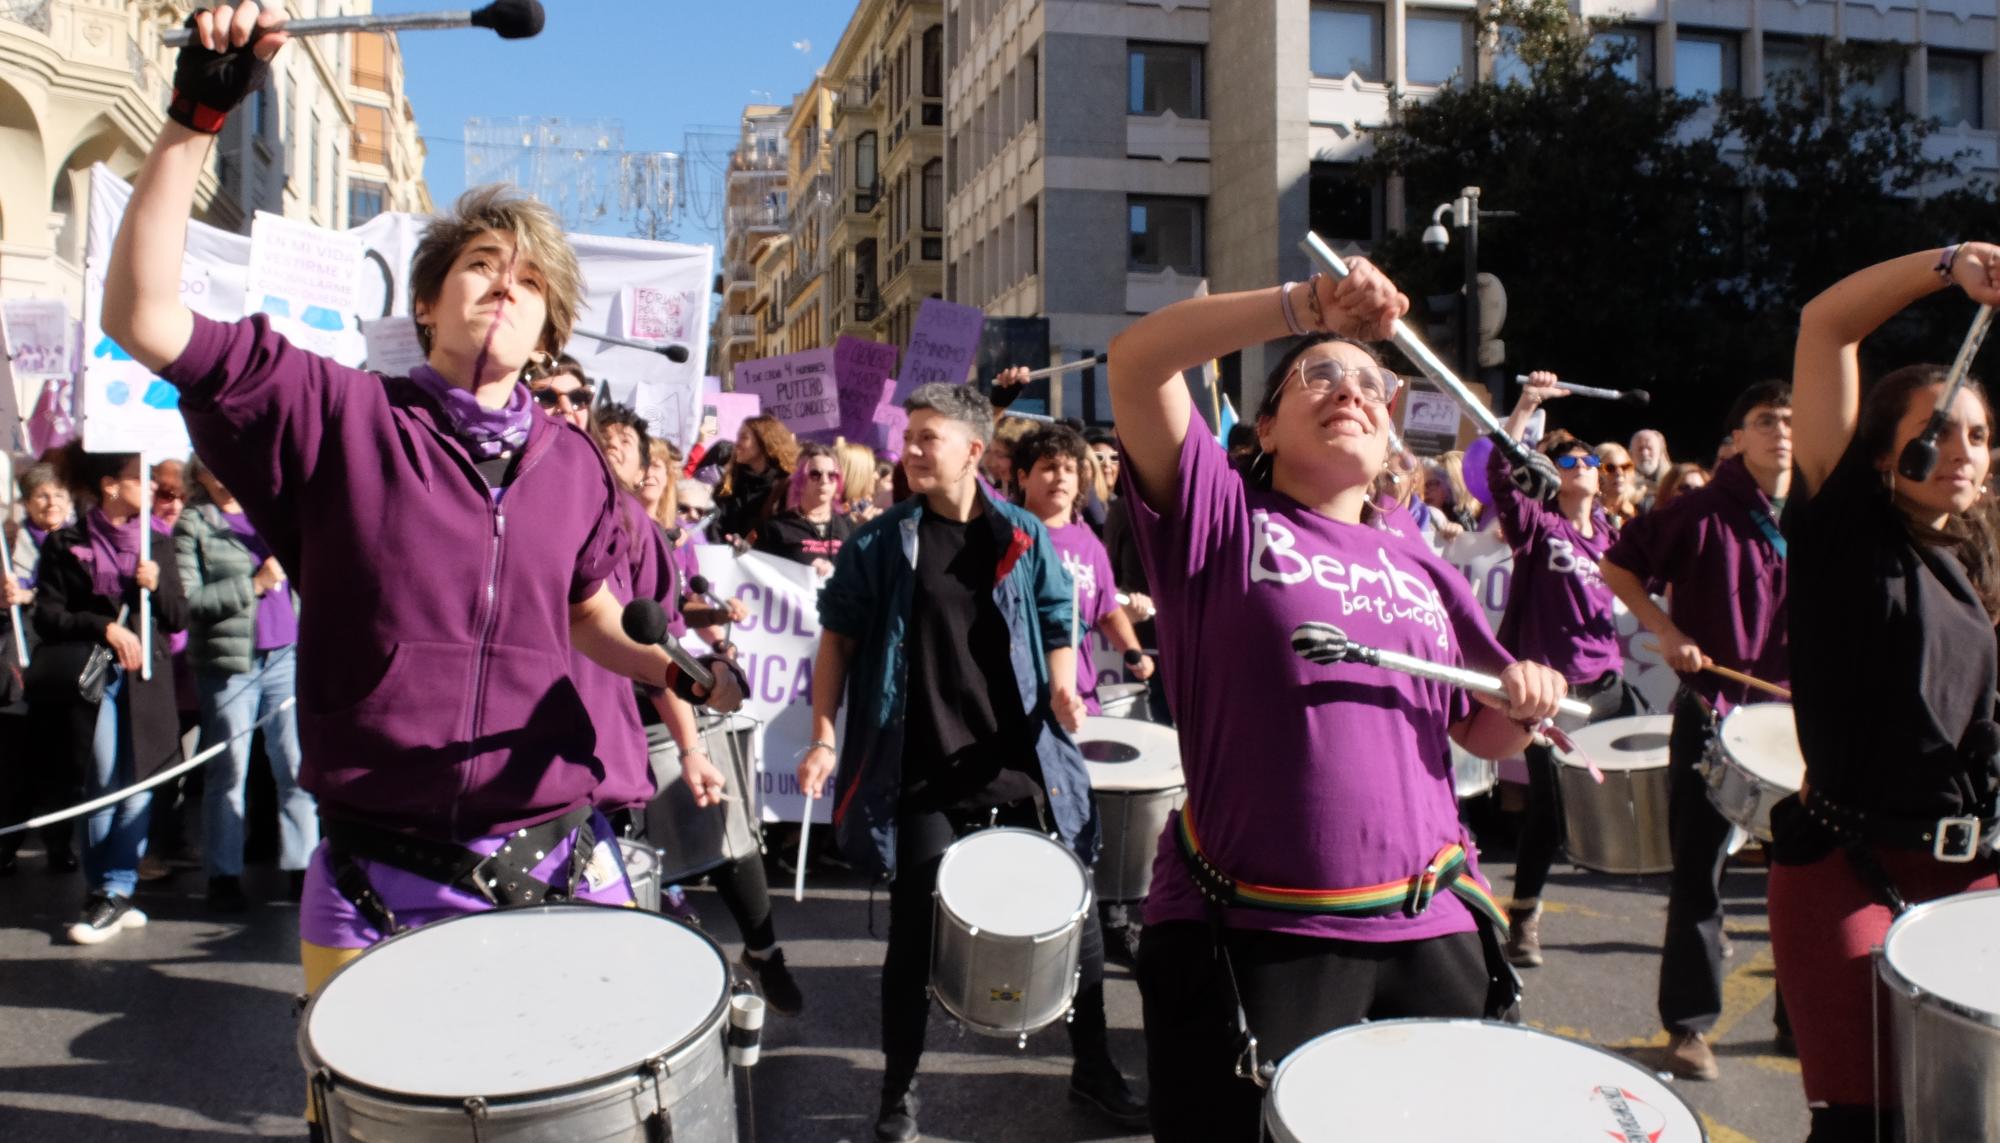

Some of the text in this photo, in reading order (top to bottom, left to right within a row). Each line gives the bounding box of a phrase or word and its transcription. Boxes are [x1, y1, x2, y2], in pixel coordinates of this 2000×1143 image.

[316, 244, 355, 263] VIDA
[744, 369, 749, 384] 1
[784, 361, 792, 377] 4
[776, 377, 823, 401] PUTERO
[737, 652, 814, 706] ICA
